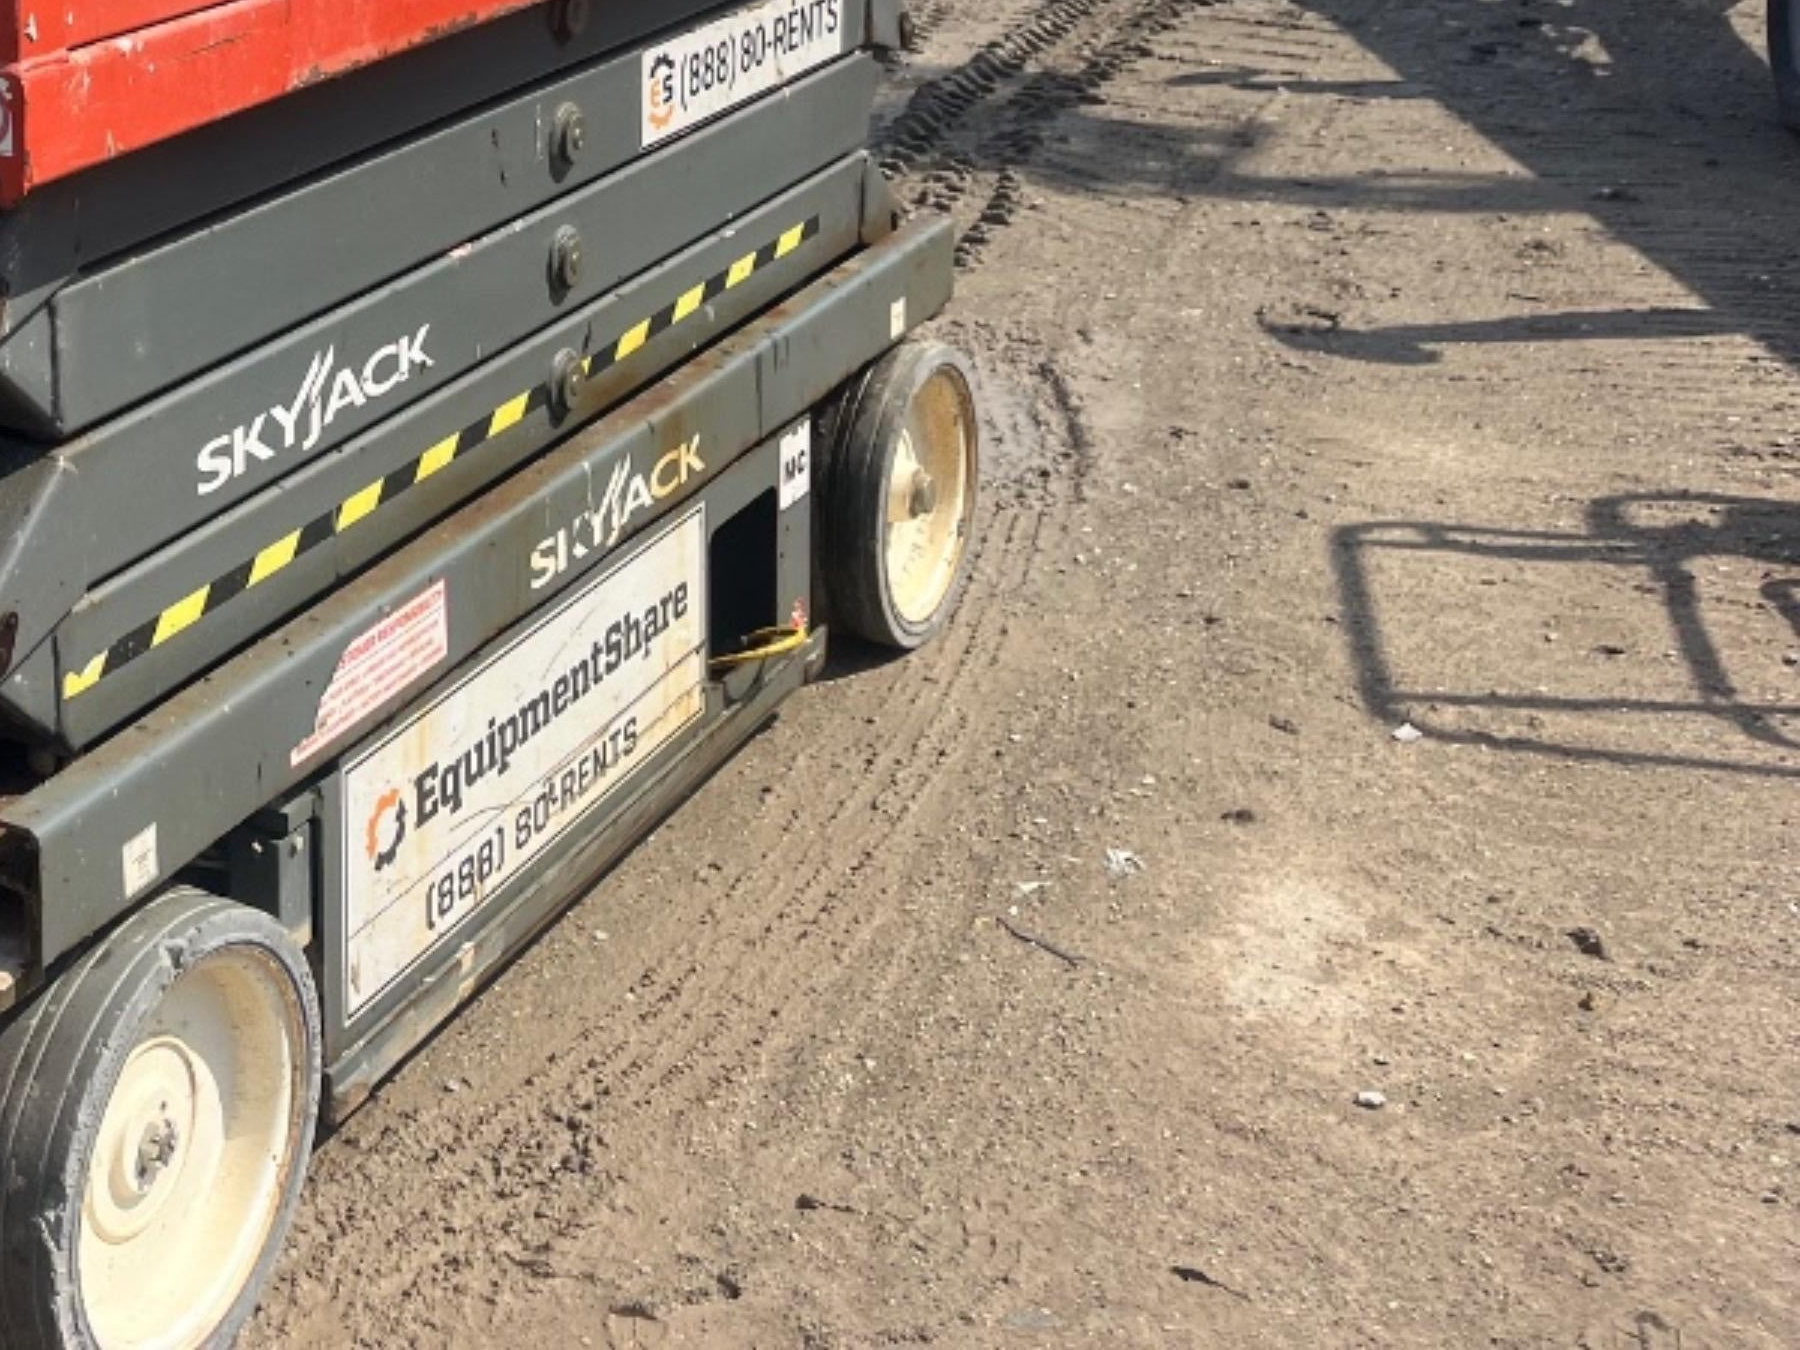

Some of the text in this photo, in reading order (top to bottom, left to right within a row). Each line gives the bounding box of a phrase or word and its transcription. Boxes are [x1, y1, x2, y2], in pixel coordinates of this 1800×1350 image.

[680, 34, 737, 112] (888)
[196, 323, 436, 496] SKYJACK
[530, 433, 707, 589] SKYJACK
[414, 580, 689, 830] EquipmentShare
[425, 826, 506, 931] (888)
